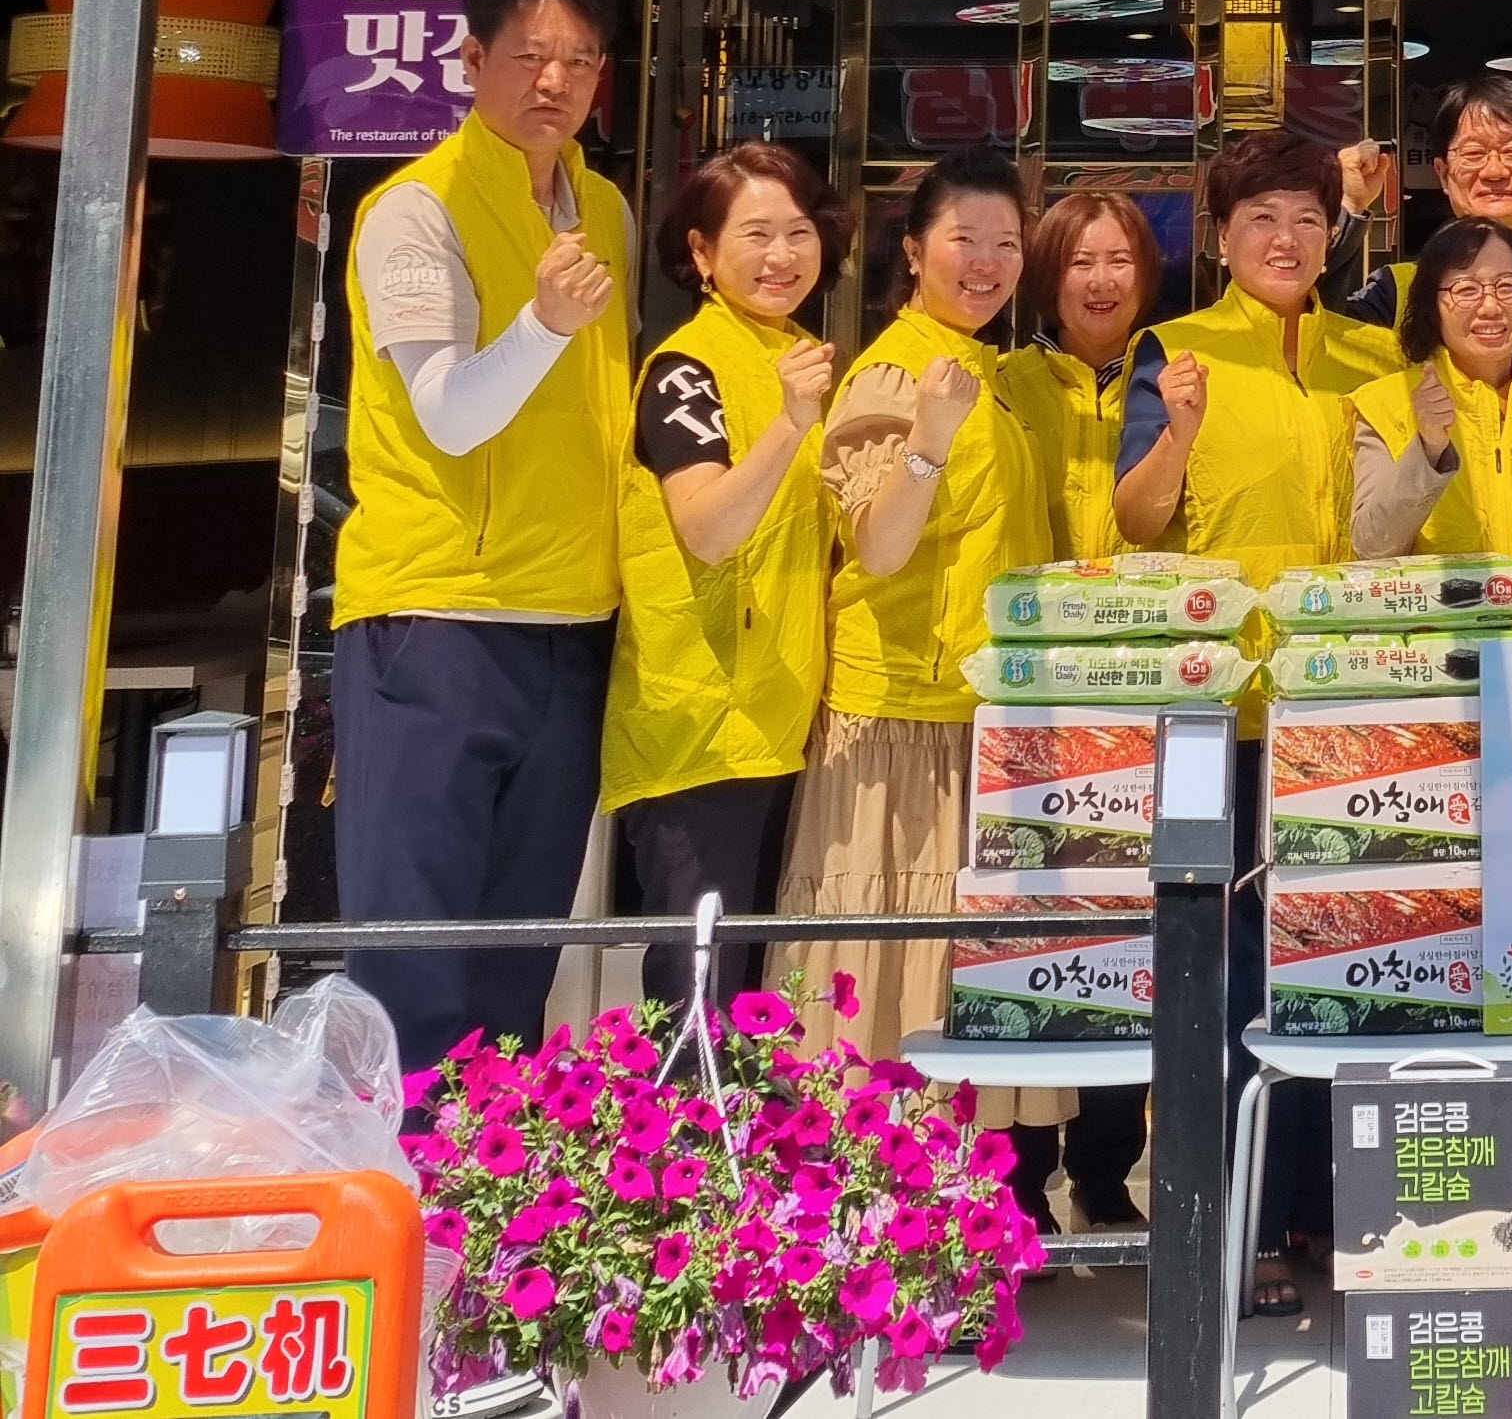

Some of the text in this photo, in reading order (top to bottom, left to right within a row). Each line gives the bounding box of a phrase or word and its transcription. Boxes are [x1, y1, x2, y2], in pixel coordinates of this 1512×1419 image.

[330, 129, 352, 142] The
[355, 129, 418, 142] restaurant
[420, 129, 436, 142] of
[1062, 601, 1087, 612] Fresh
[1342, 590, 1364, 603] 성경
[1383, 595, 1428, 613] 녹차김
[1063, 609, 1085, 620] Daily
[1094, 609, 1168, 624] 신선한 들기름
[1054, 663, 1080, 674] Fresh
[1347, 657, 1369, 670] 성경
[1389, 665, 1433, 682] 녹차김
[1055, 671, 1078, 683] Daily
[1086, 671, 1162, 686] 신선한 들기름
[1041, 781, 1139, 822] 아침애
[1347, 780, 1445, 823] 아침애
[1028, 954, 1128, 999] 아침애
[1346, 949, 1445, 993] 아침애
[1394, 1101, 1470, 1134] 검은콩
[1395, 1135, 1496, 1168] 검은참깨
[1395, 1171, 1472, 1203] 고칼슘
[1408, 1311, 1485, 1344] 검은콩
[62, 1297, 352, 1407] 三七机
[1409, 1346, 1511, 1380] 검은참깨
[1410, 1382, 1486, 1415] 고칼슘
